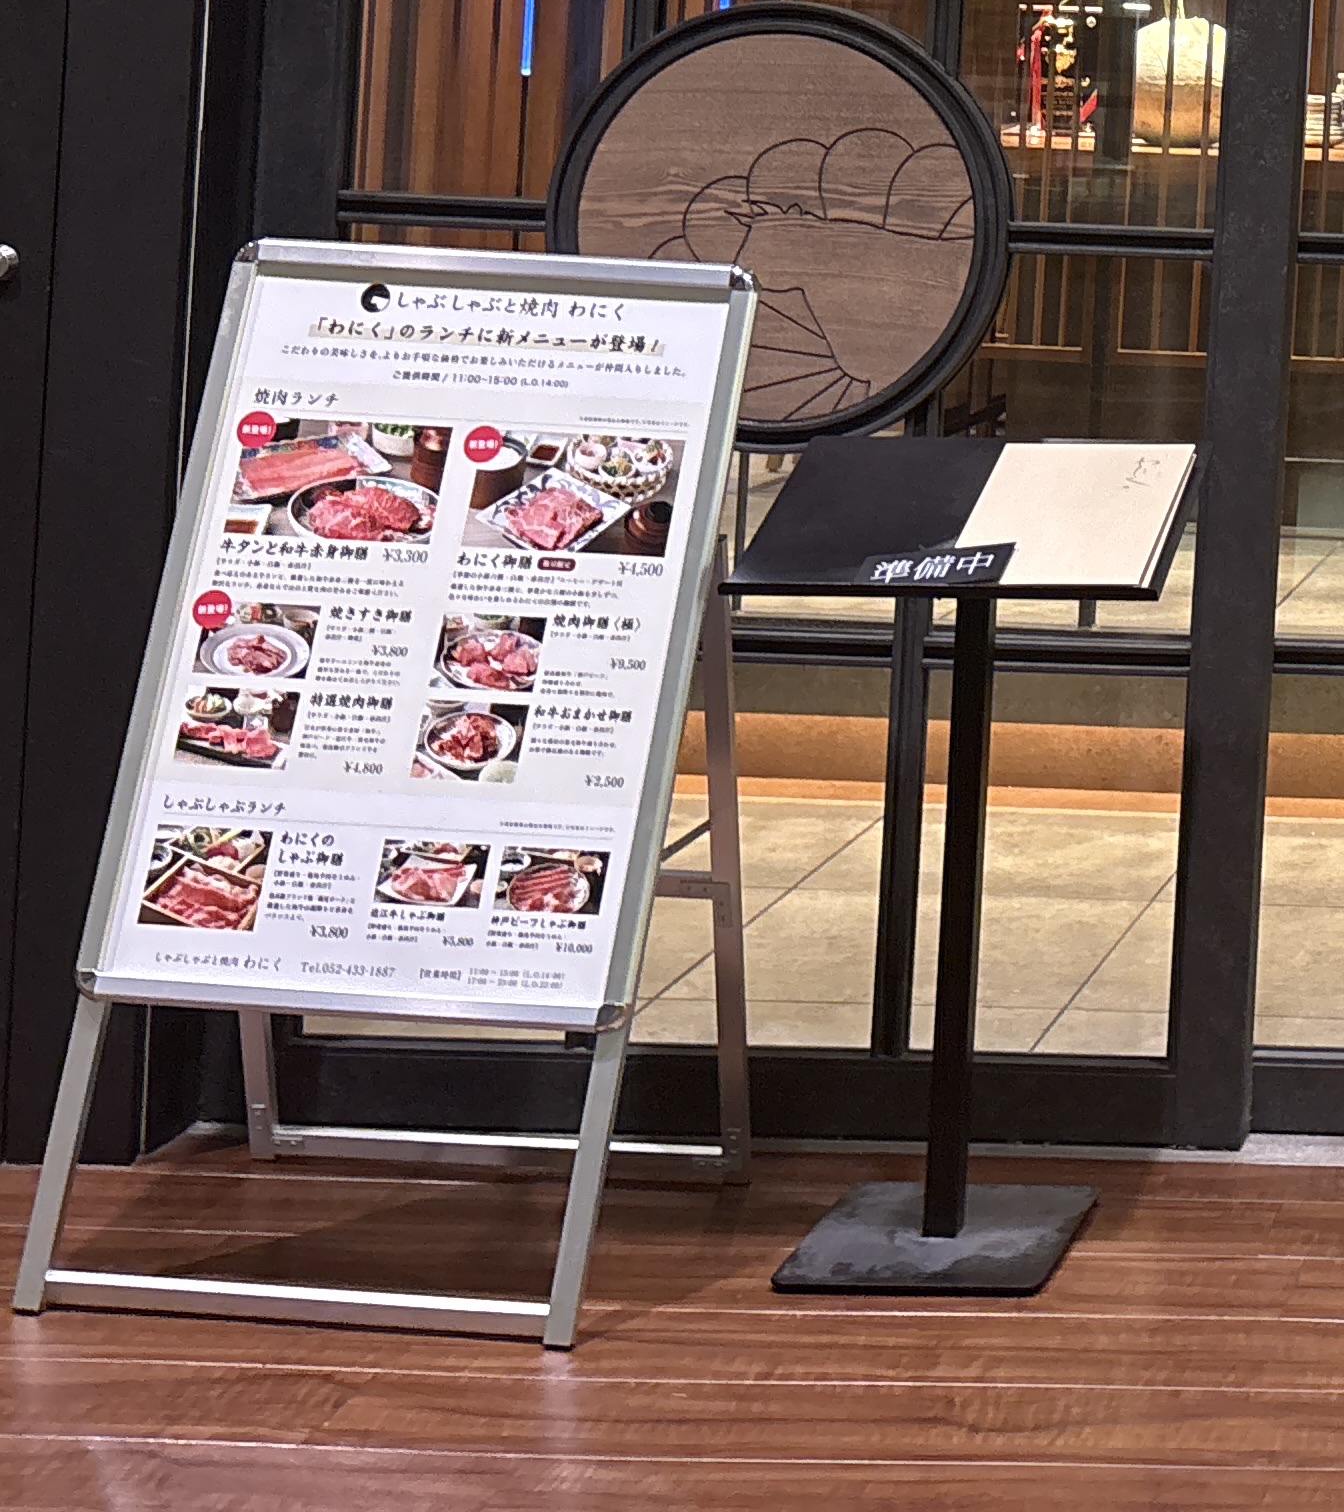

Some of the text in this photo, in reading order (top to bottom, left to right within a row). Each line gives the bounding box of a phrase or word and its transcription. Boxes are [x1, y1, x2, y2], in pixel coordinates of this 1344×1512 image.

[398, 291, 624, 321] しゃぶしゃぶと焼肉 わにく
[253, 387, 340, 407] 焼肉ランチ
[220, 537, 369, 561] 牛タンと和牛赤身御膳
[456, 551, 533, 570] わにく御膳
[870, 551, 995, 584] 準備中
[329, 605, 413, 623] 焼きすき御膳
[309, 691, 394, 710] 特選焼肉御膳
[534, 704, 632, 724] 和牛おまかせ御膳
[163, 794, 287, 816] しゃぶしゃぶランチ
[279, 830, 336, 848] わにくの
[277, 849, 345, 867] しゃぶ御膳
[243, 953, 282, 972] わにく
